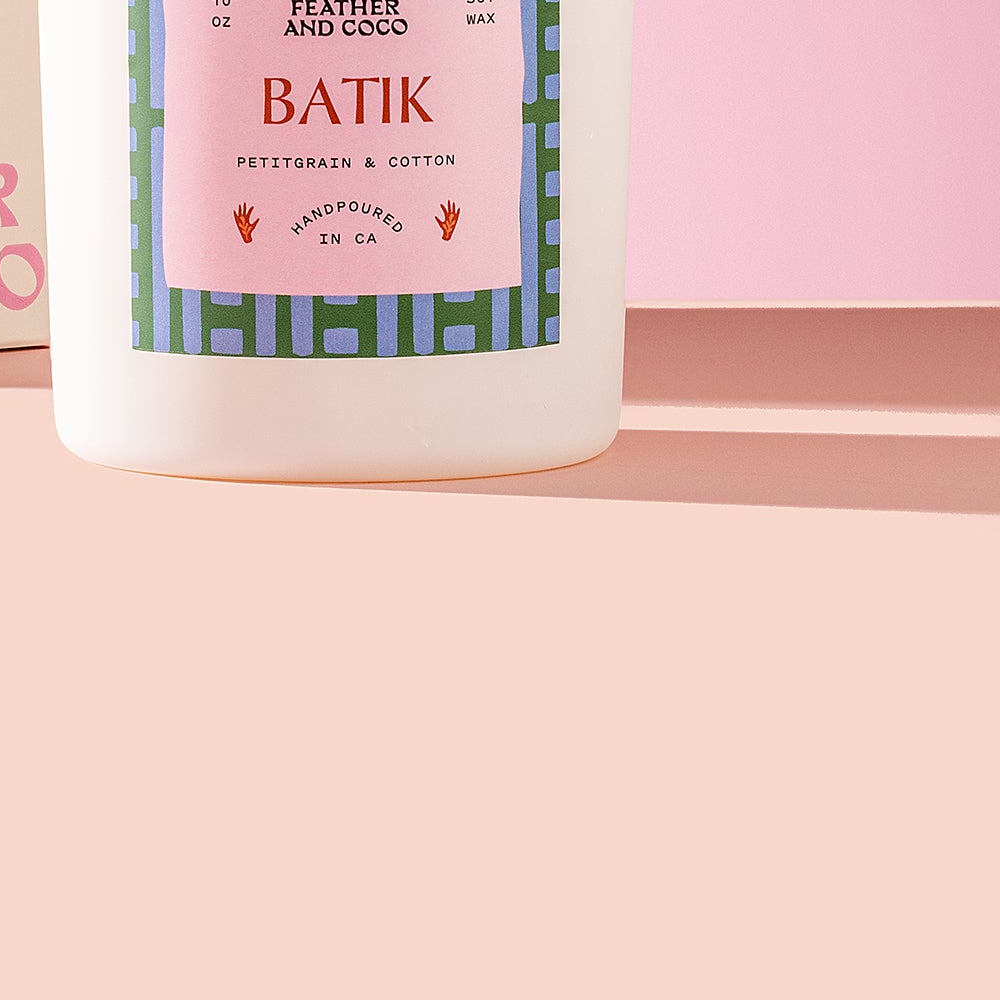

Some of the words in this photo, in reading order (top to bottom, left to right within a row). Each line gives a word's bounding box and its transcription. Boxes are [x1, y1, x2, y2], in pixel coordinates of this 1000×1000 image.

[211, 16, 231, 28] OZ
[466, 12, 496, 25] WAX
[283, 19, 334, 37] AND
[341, 18, 408, 37] COCO
[263, 75, 434, 125] BATIK
[237, 156, 351, 169] PETITGRAIN
[364, 156, 376, 169] &
[388, 154, 455, 168] COTTON
[290, 200, 403, 236] HANDPOURED
[319, 233, 341, 245] IN
[354, 232, 377, 245] CA
